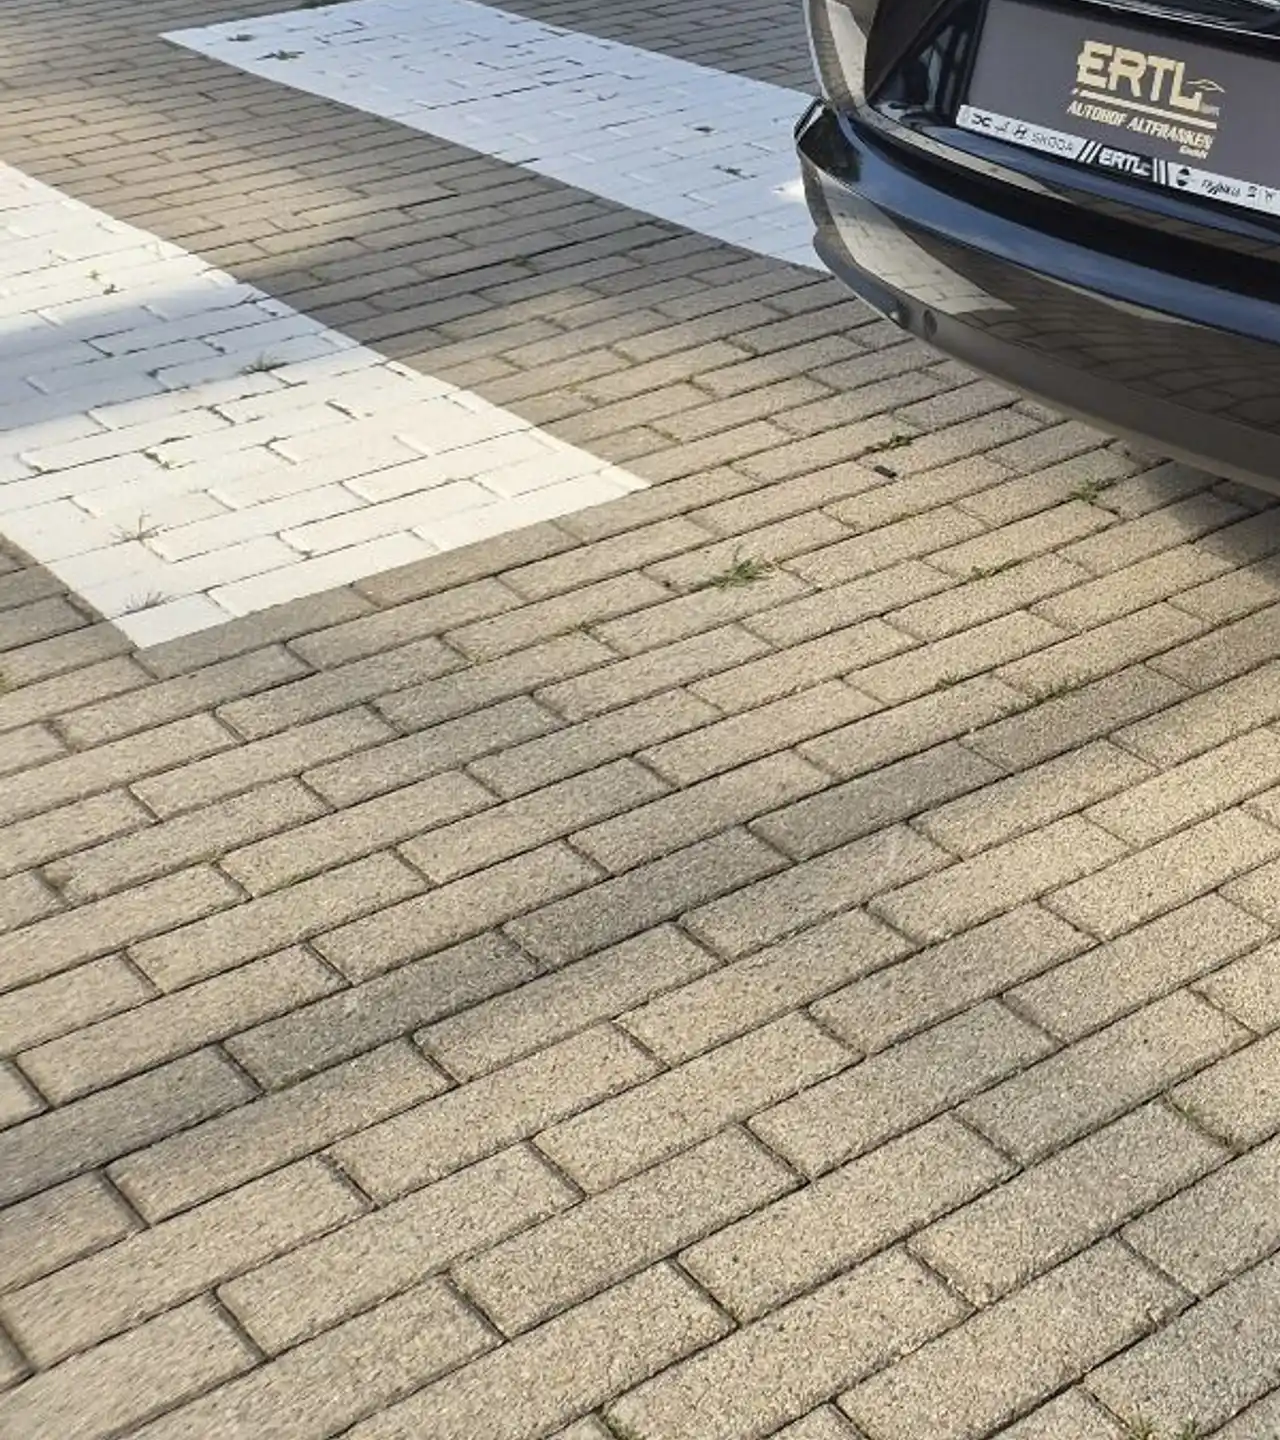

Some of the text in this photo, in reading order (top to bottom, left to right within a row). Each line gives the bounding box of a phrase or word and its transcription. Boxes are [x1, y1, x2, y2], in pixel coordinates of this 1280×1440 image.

[1076, 40, 1203, 112] ERTL
[1067, 100, 1128, 128] AUTOHOF
[1099, 146, 1150, 176] ERTL
